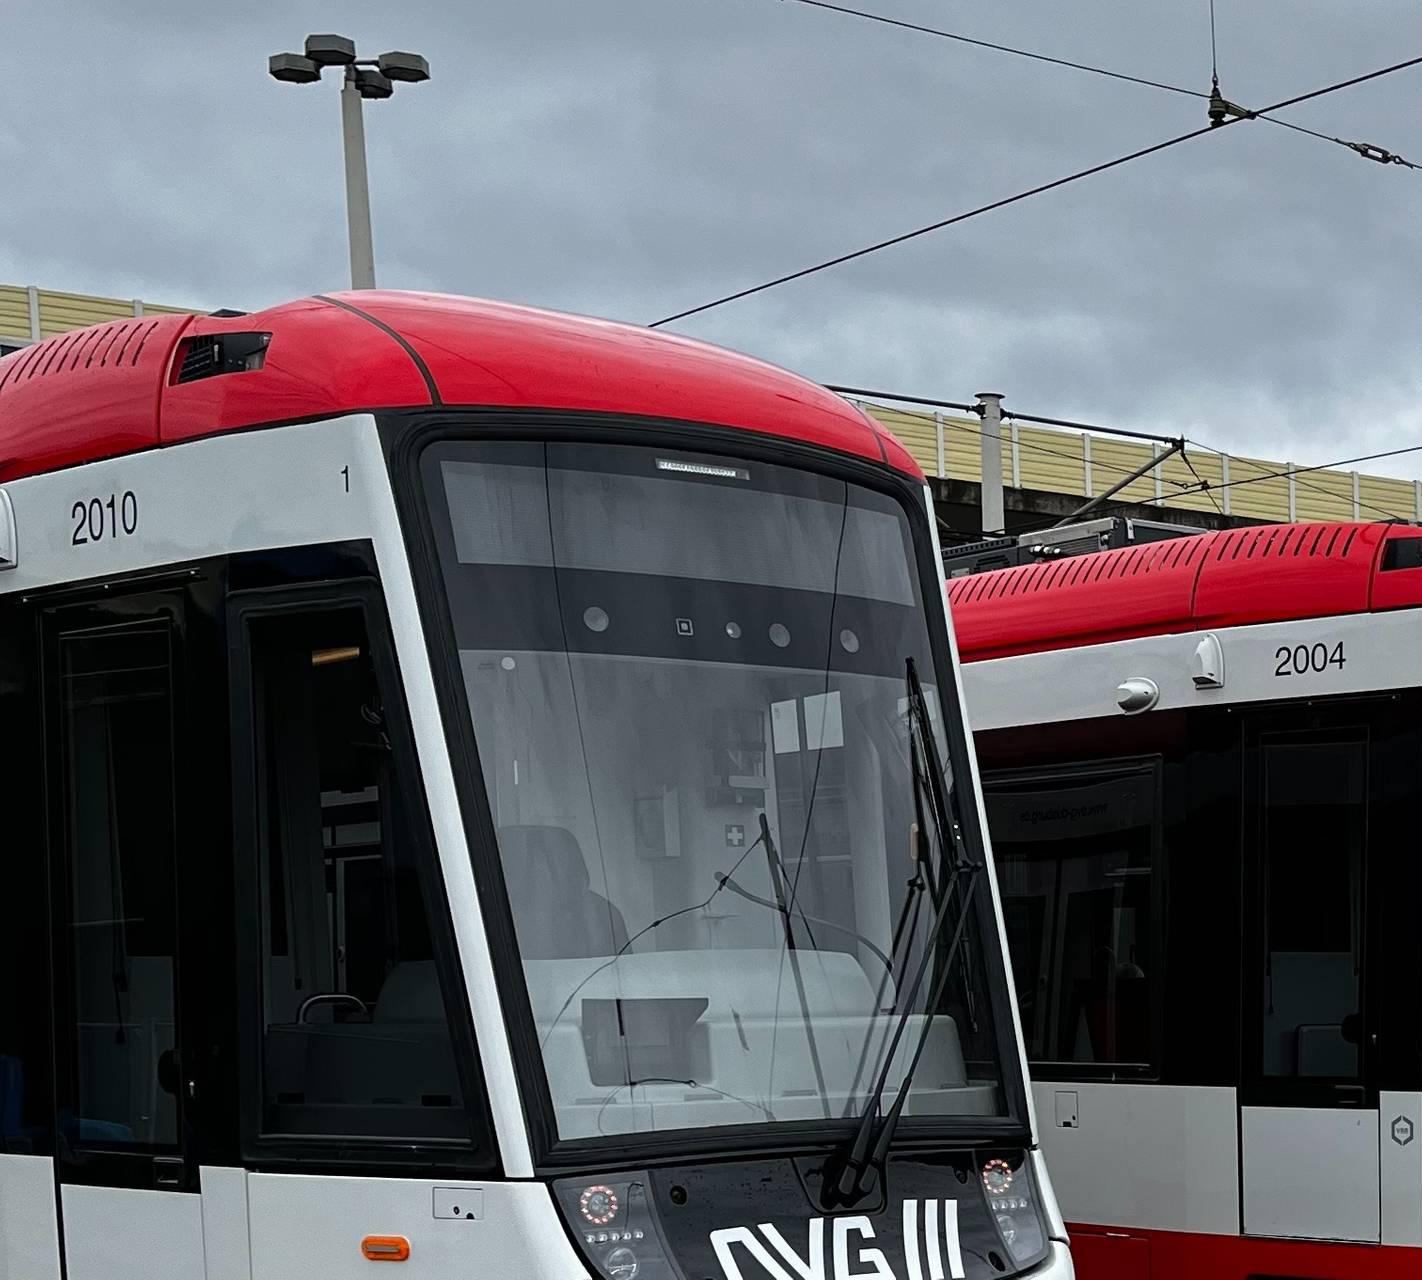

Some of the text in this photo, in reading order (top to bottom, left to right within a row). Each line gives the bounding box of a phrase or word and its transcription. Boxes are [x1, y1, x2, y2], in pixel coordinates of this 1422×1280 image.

[340, 465, 349, 493] 1
[71, 490, 138, 546] 2010
[1274, 641, 1347, 677] 2004
